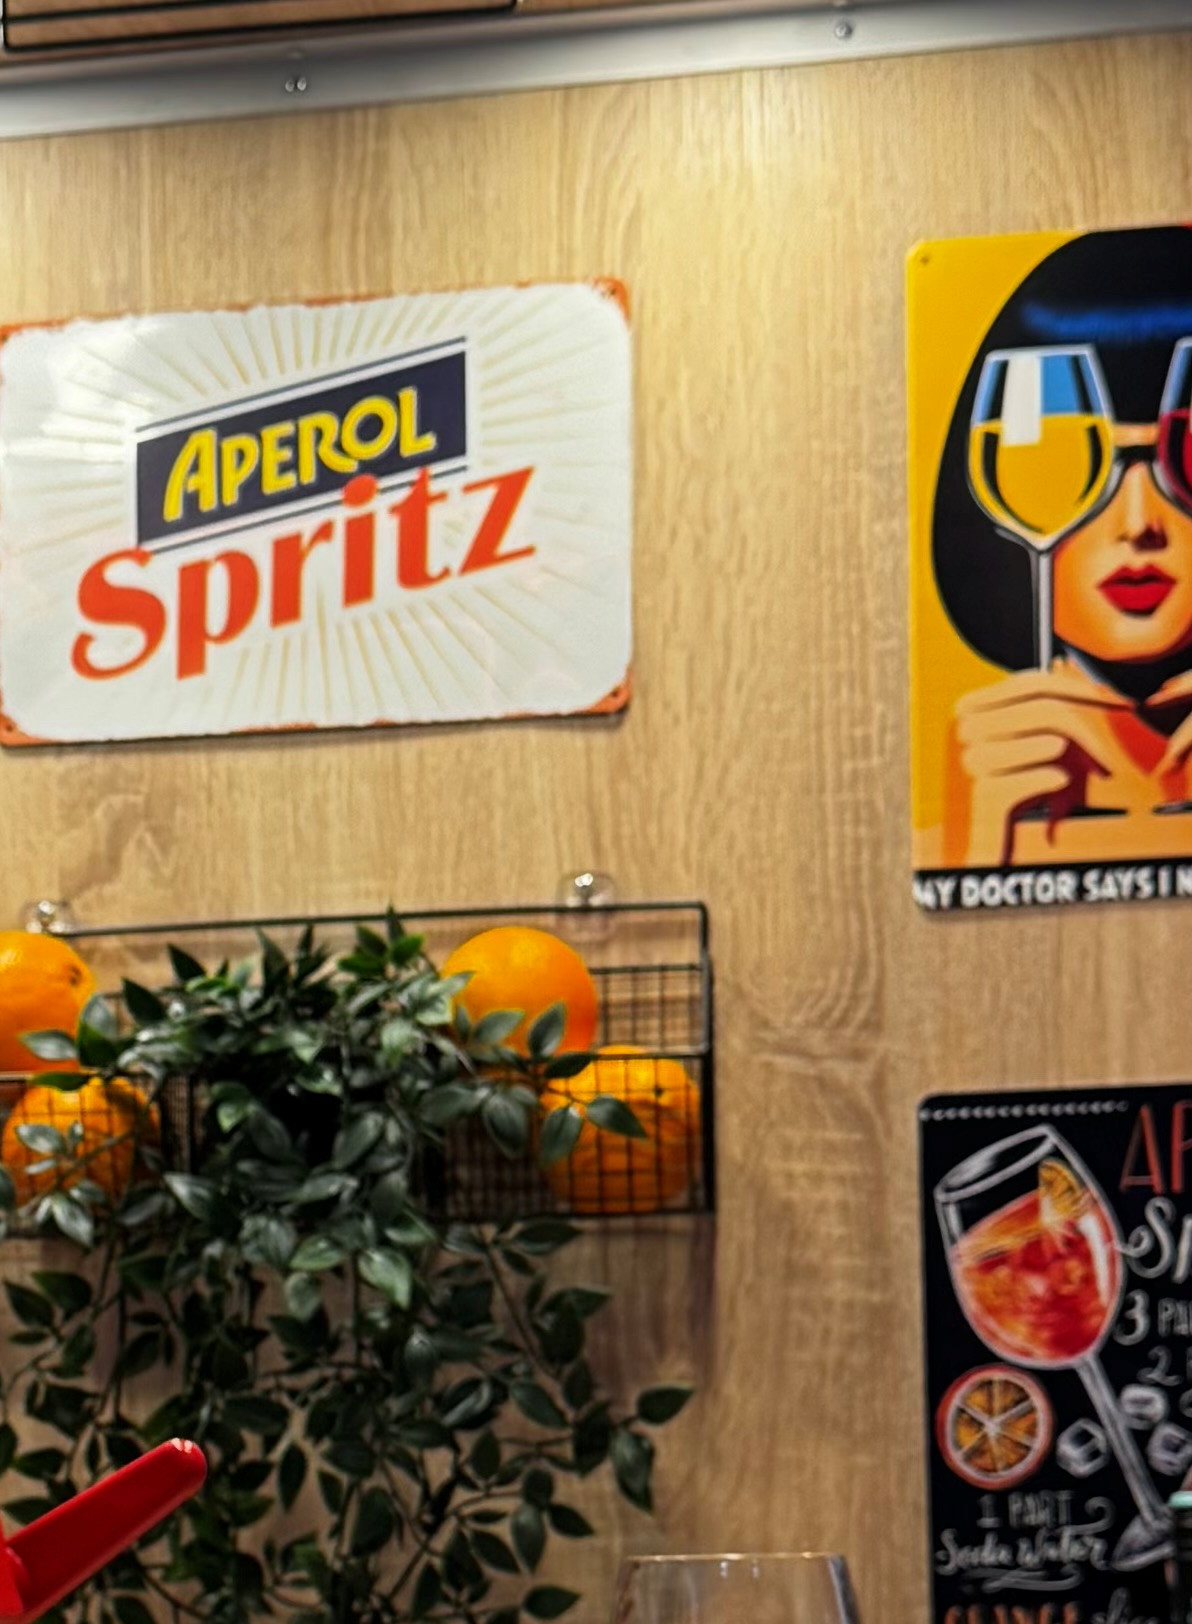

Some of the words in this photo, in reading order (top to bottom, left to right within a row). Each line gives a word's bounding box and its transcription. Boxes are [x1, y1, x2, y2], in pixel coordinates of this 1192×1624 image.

[162, 386, 437, 523] APEROL
[70, 464, 537, 682] Spritz
[960, 869, 1079, 909] DOCTOR
[1081, 864, 1157, 902] SAYS
[1157, 864, 1174, 899] I
[1112, 1289, 1151, 1346] 3
